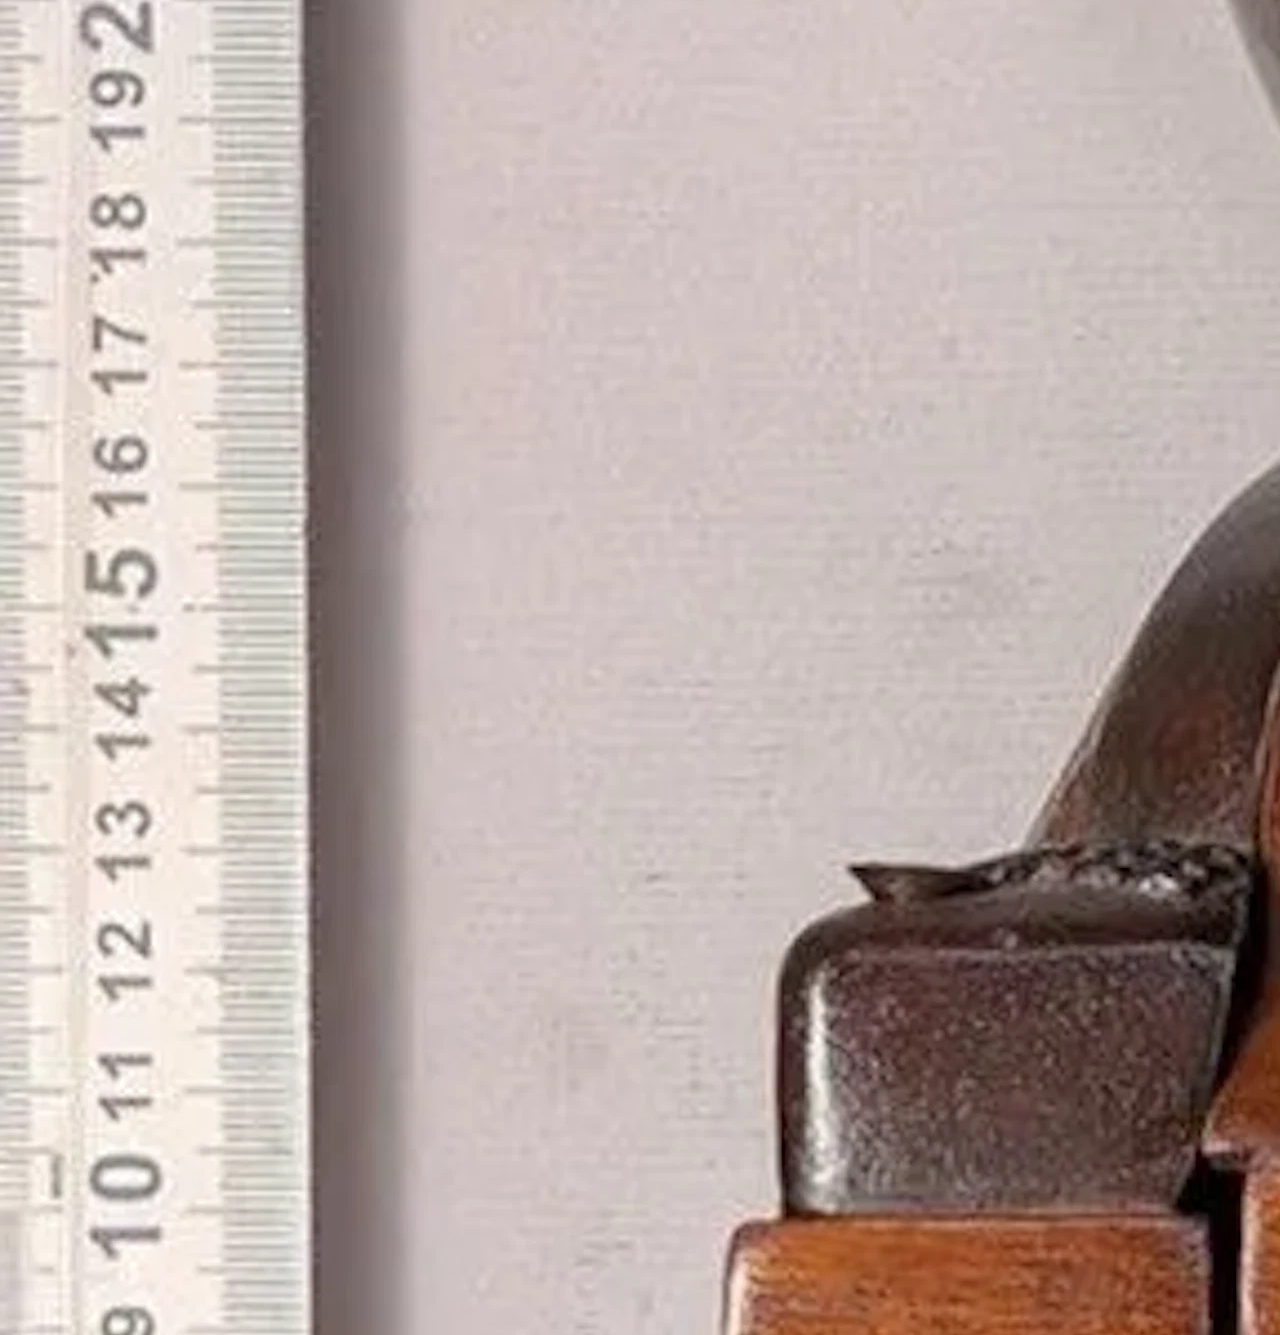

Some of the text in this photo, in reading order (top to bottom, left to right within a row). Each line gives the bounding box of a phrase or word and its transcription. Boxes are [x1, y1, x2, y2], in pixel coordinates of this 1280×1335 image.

[88, 70, 146, 151] 19
[90, 193, 147, 275] 18
[91, 315, 148, 396] 17
[91, 434, 149, 517] 16
[84, 547, 158, 659] 15
[94, 677, 150, 761] 14
[96, 799, 151, 882] 13
[97, 921, 152, 1001] 12
[98, 1052, 153, 1121] 11
[90, 1154, 162, 1260] 10
